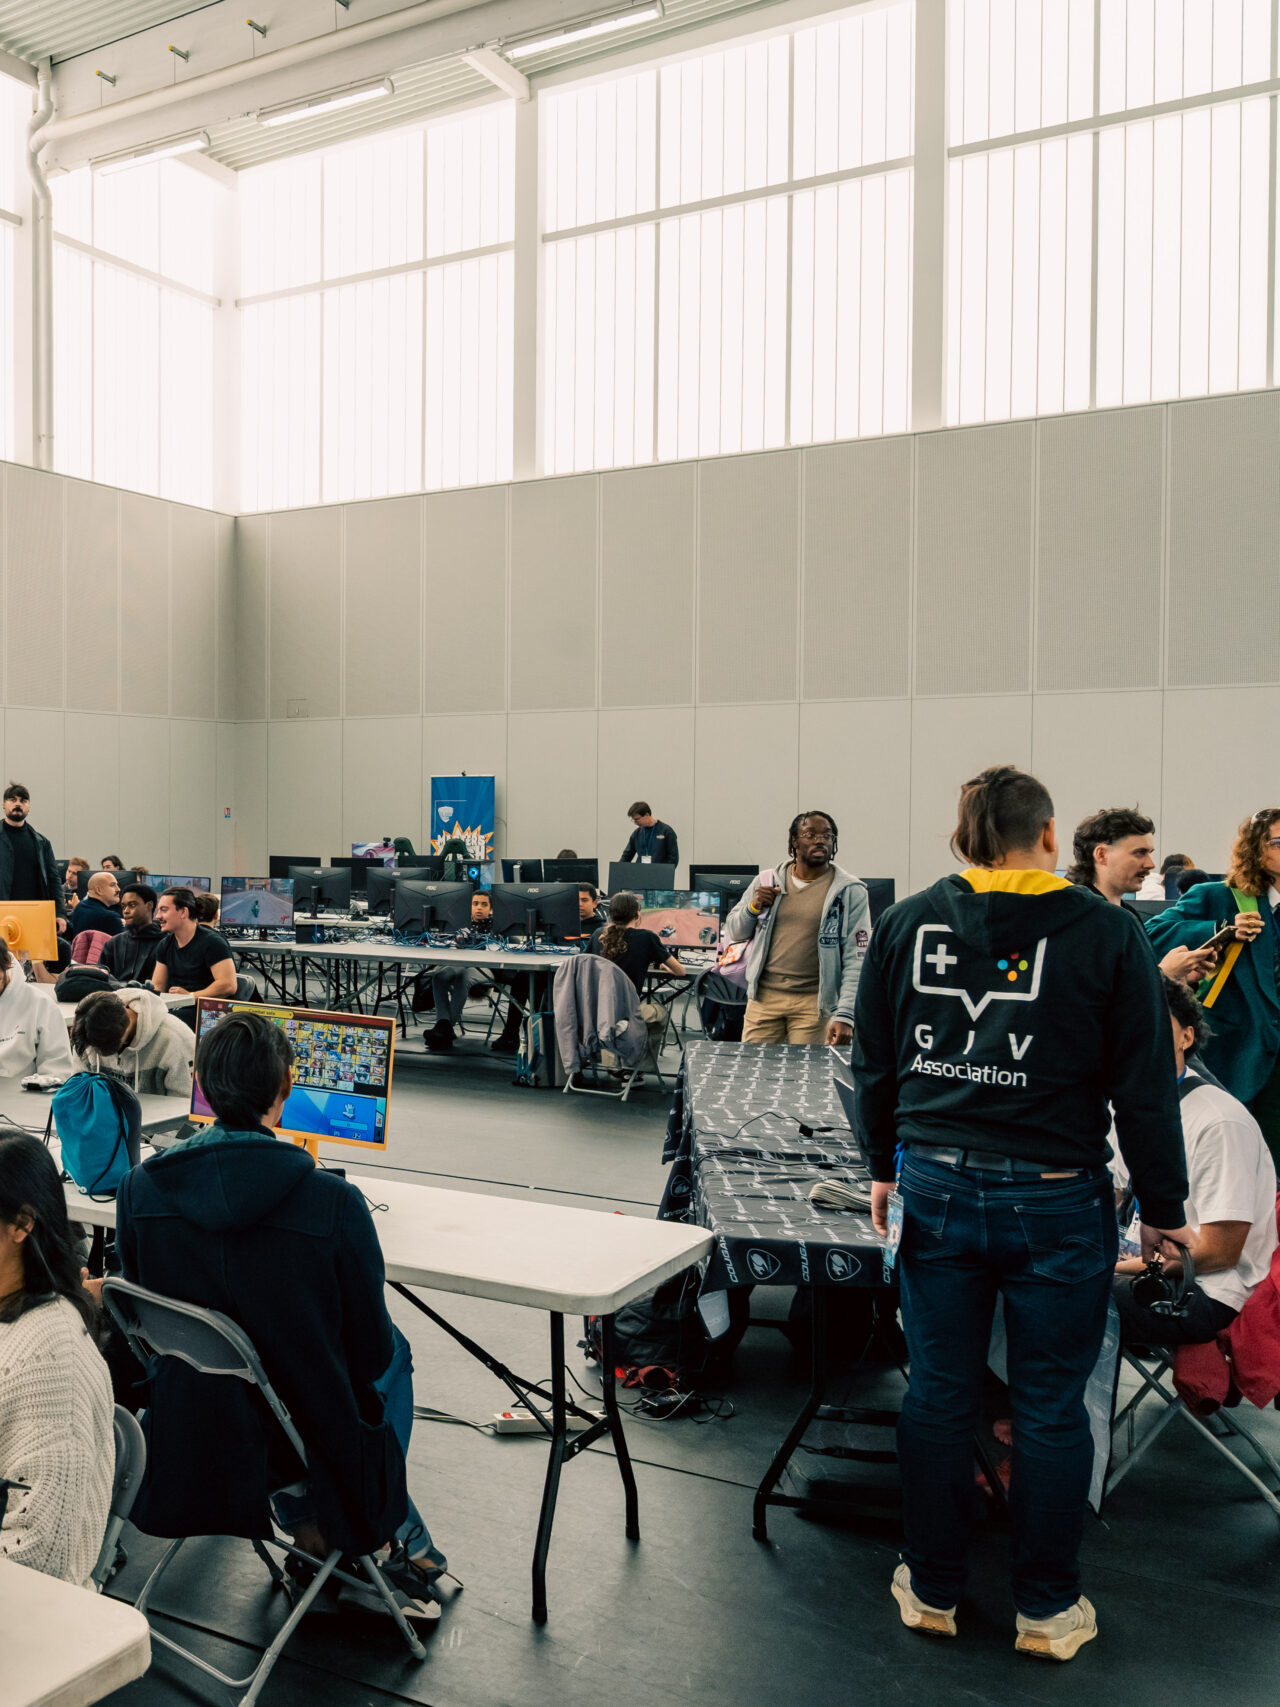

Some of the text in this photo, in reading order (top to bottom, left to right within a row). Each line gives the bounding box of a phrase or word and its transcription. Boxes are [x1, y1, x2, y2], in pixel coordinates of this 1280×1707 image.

[435, 833, 486, 848] MTERS
[910, 1054, 1028, 1088] Association
[798, 1239, 810, 1282] COUGA
